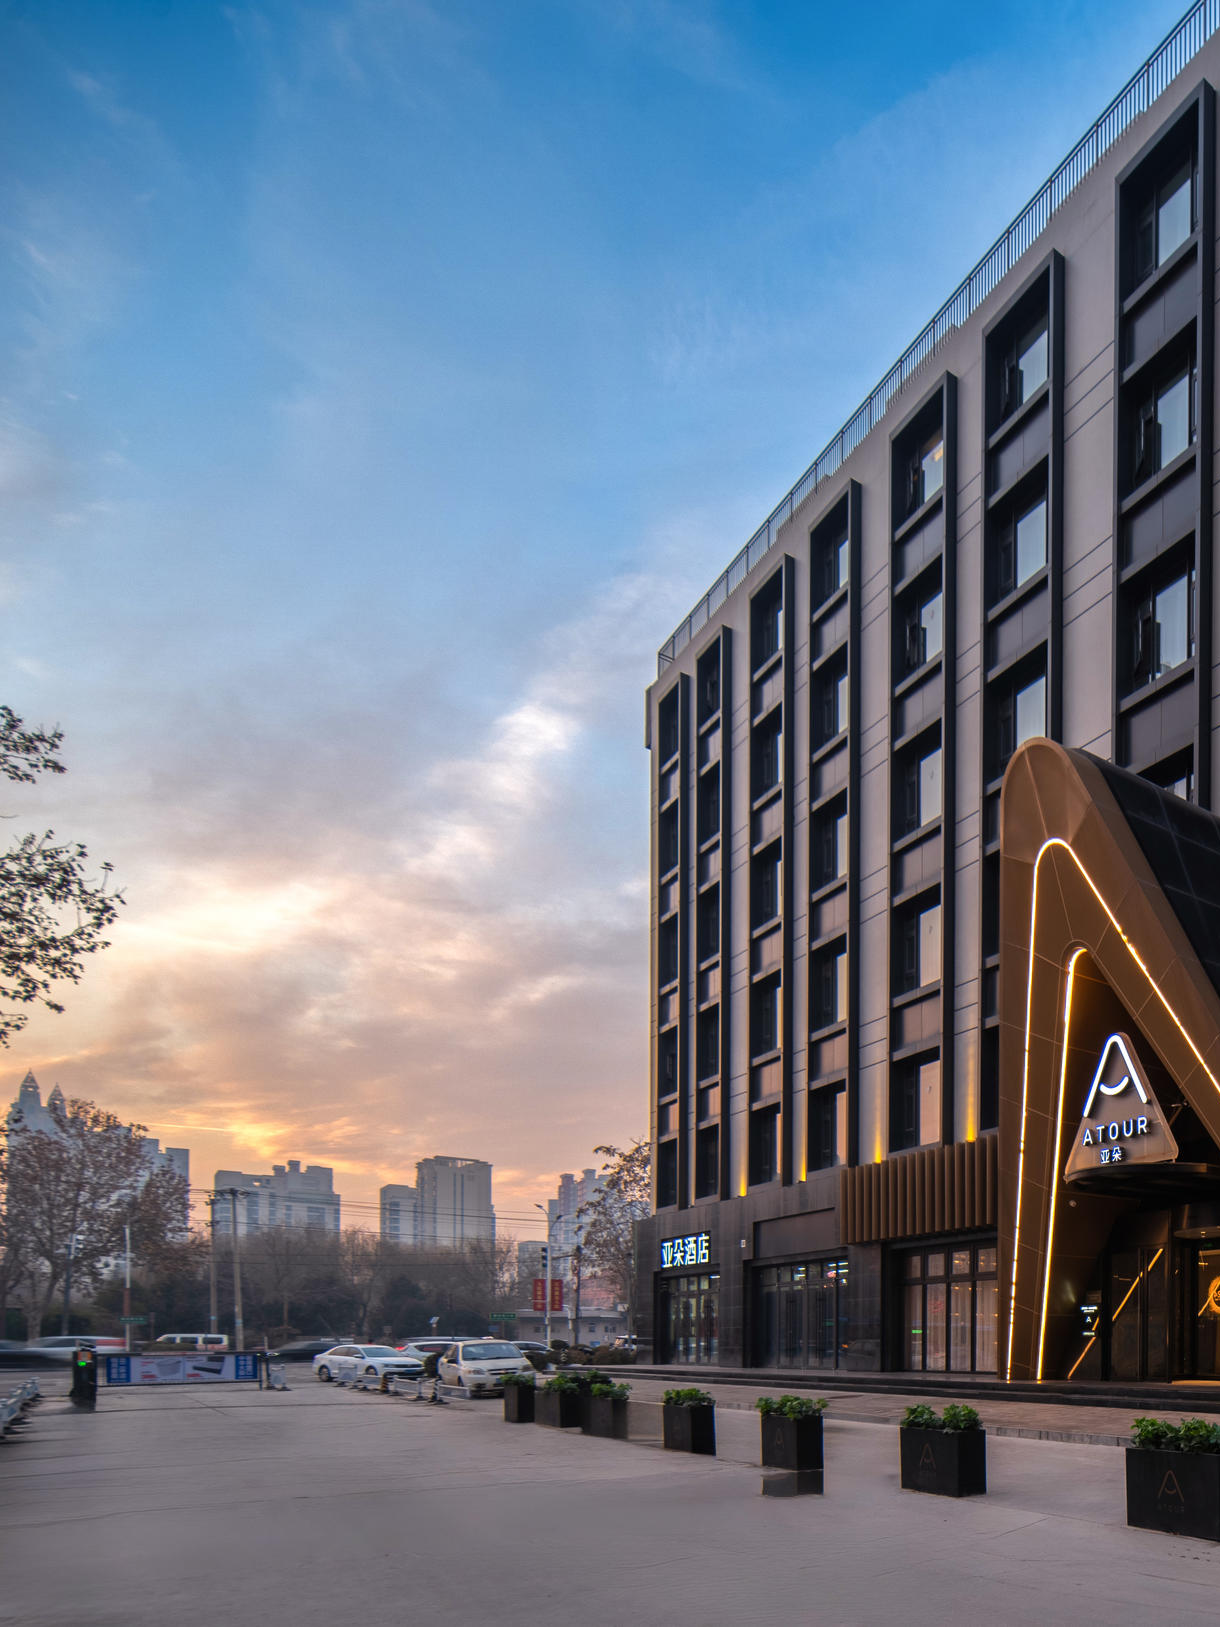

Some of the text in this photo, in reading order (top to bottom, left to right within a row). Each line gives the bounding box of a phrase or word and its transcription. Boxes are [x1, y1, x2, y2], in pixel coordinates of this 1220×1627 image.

[1082, 1115, 1149, 1146] ATOUR
[1100, 1146, 1123, 1164] 亚朵
[661, 1232, 711, 1268] 亚朵酒店
